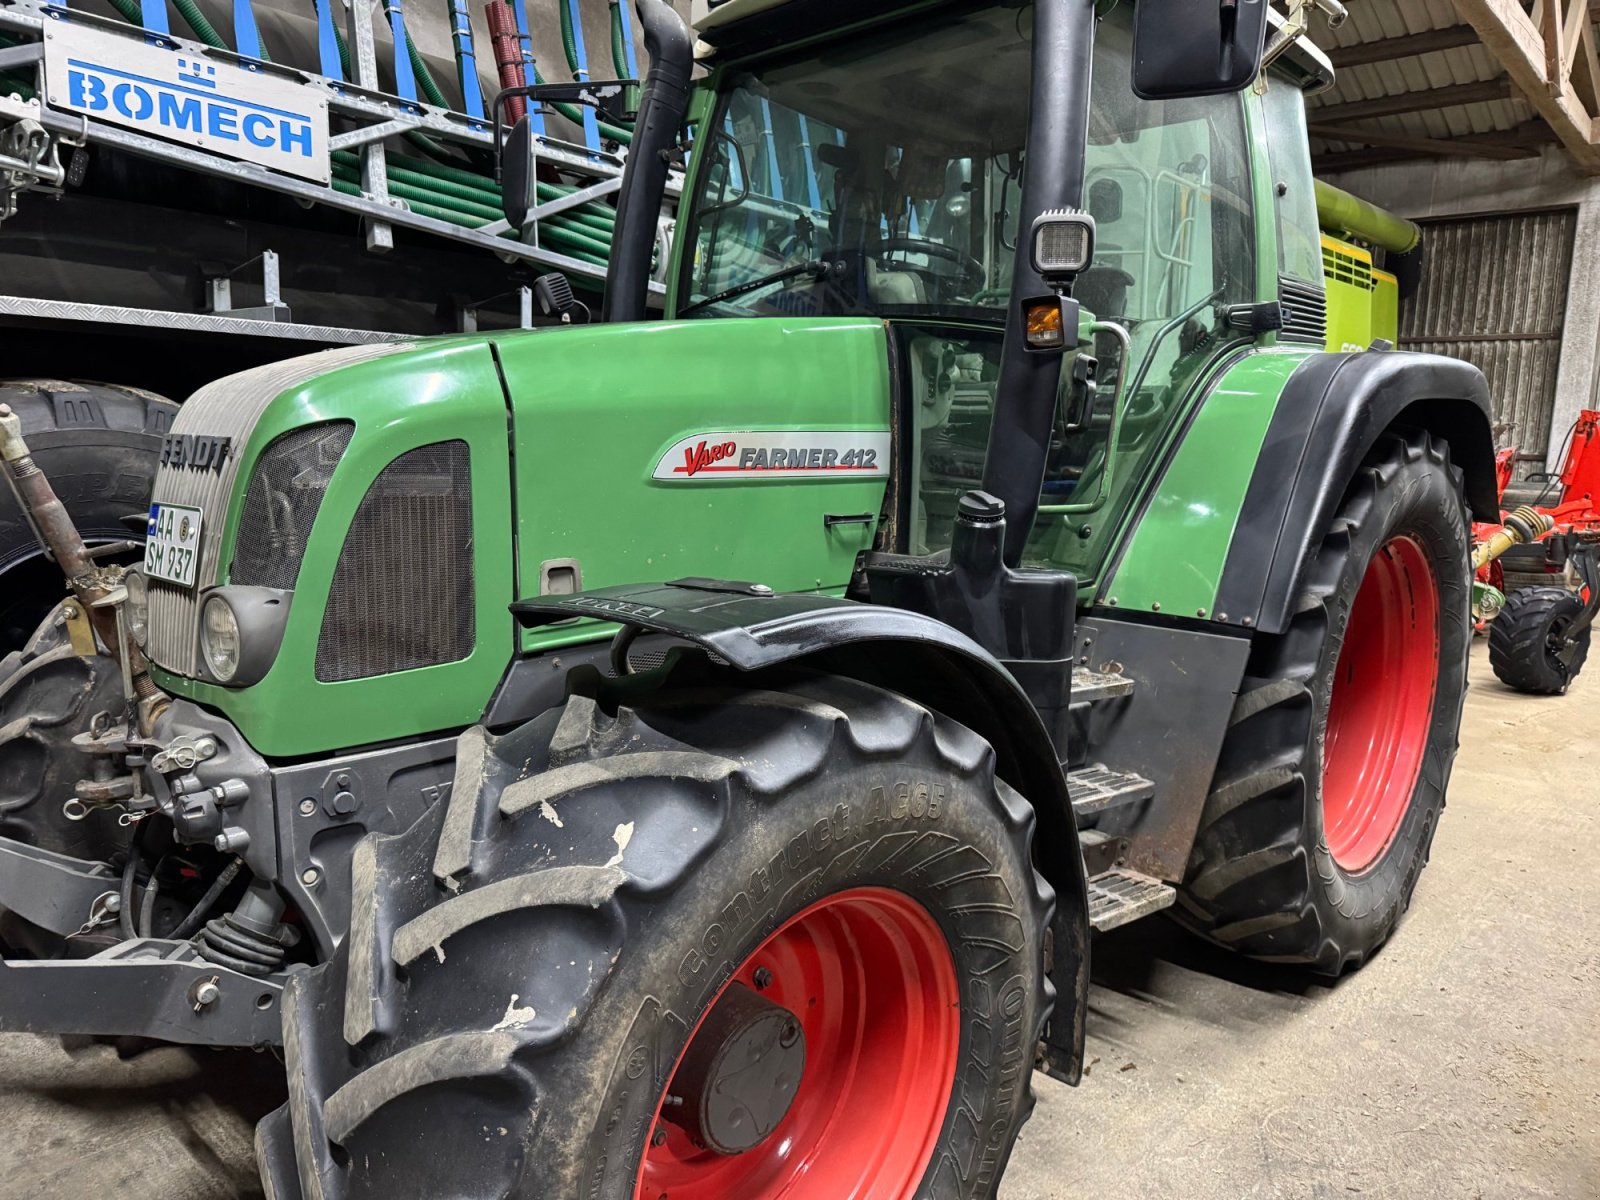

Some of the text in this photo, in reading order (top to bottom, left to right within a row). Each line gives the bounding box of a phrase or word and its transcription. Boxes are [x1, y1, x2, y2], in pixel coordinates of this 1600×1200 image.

[68, 69, 313, 158] BOMECH
[160, 433, 230, 472] FENDT
[684, 440, 878, 477] VARIO FARMER 412
[155, 509, 175, 541] AA
[146, 542, 193, 581] SM 937
